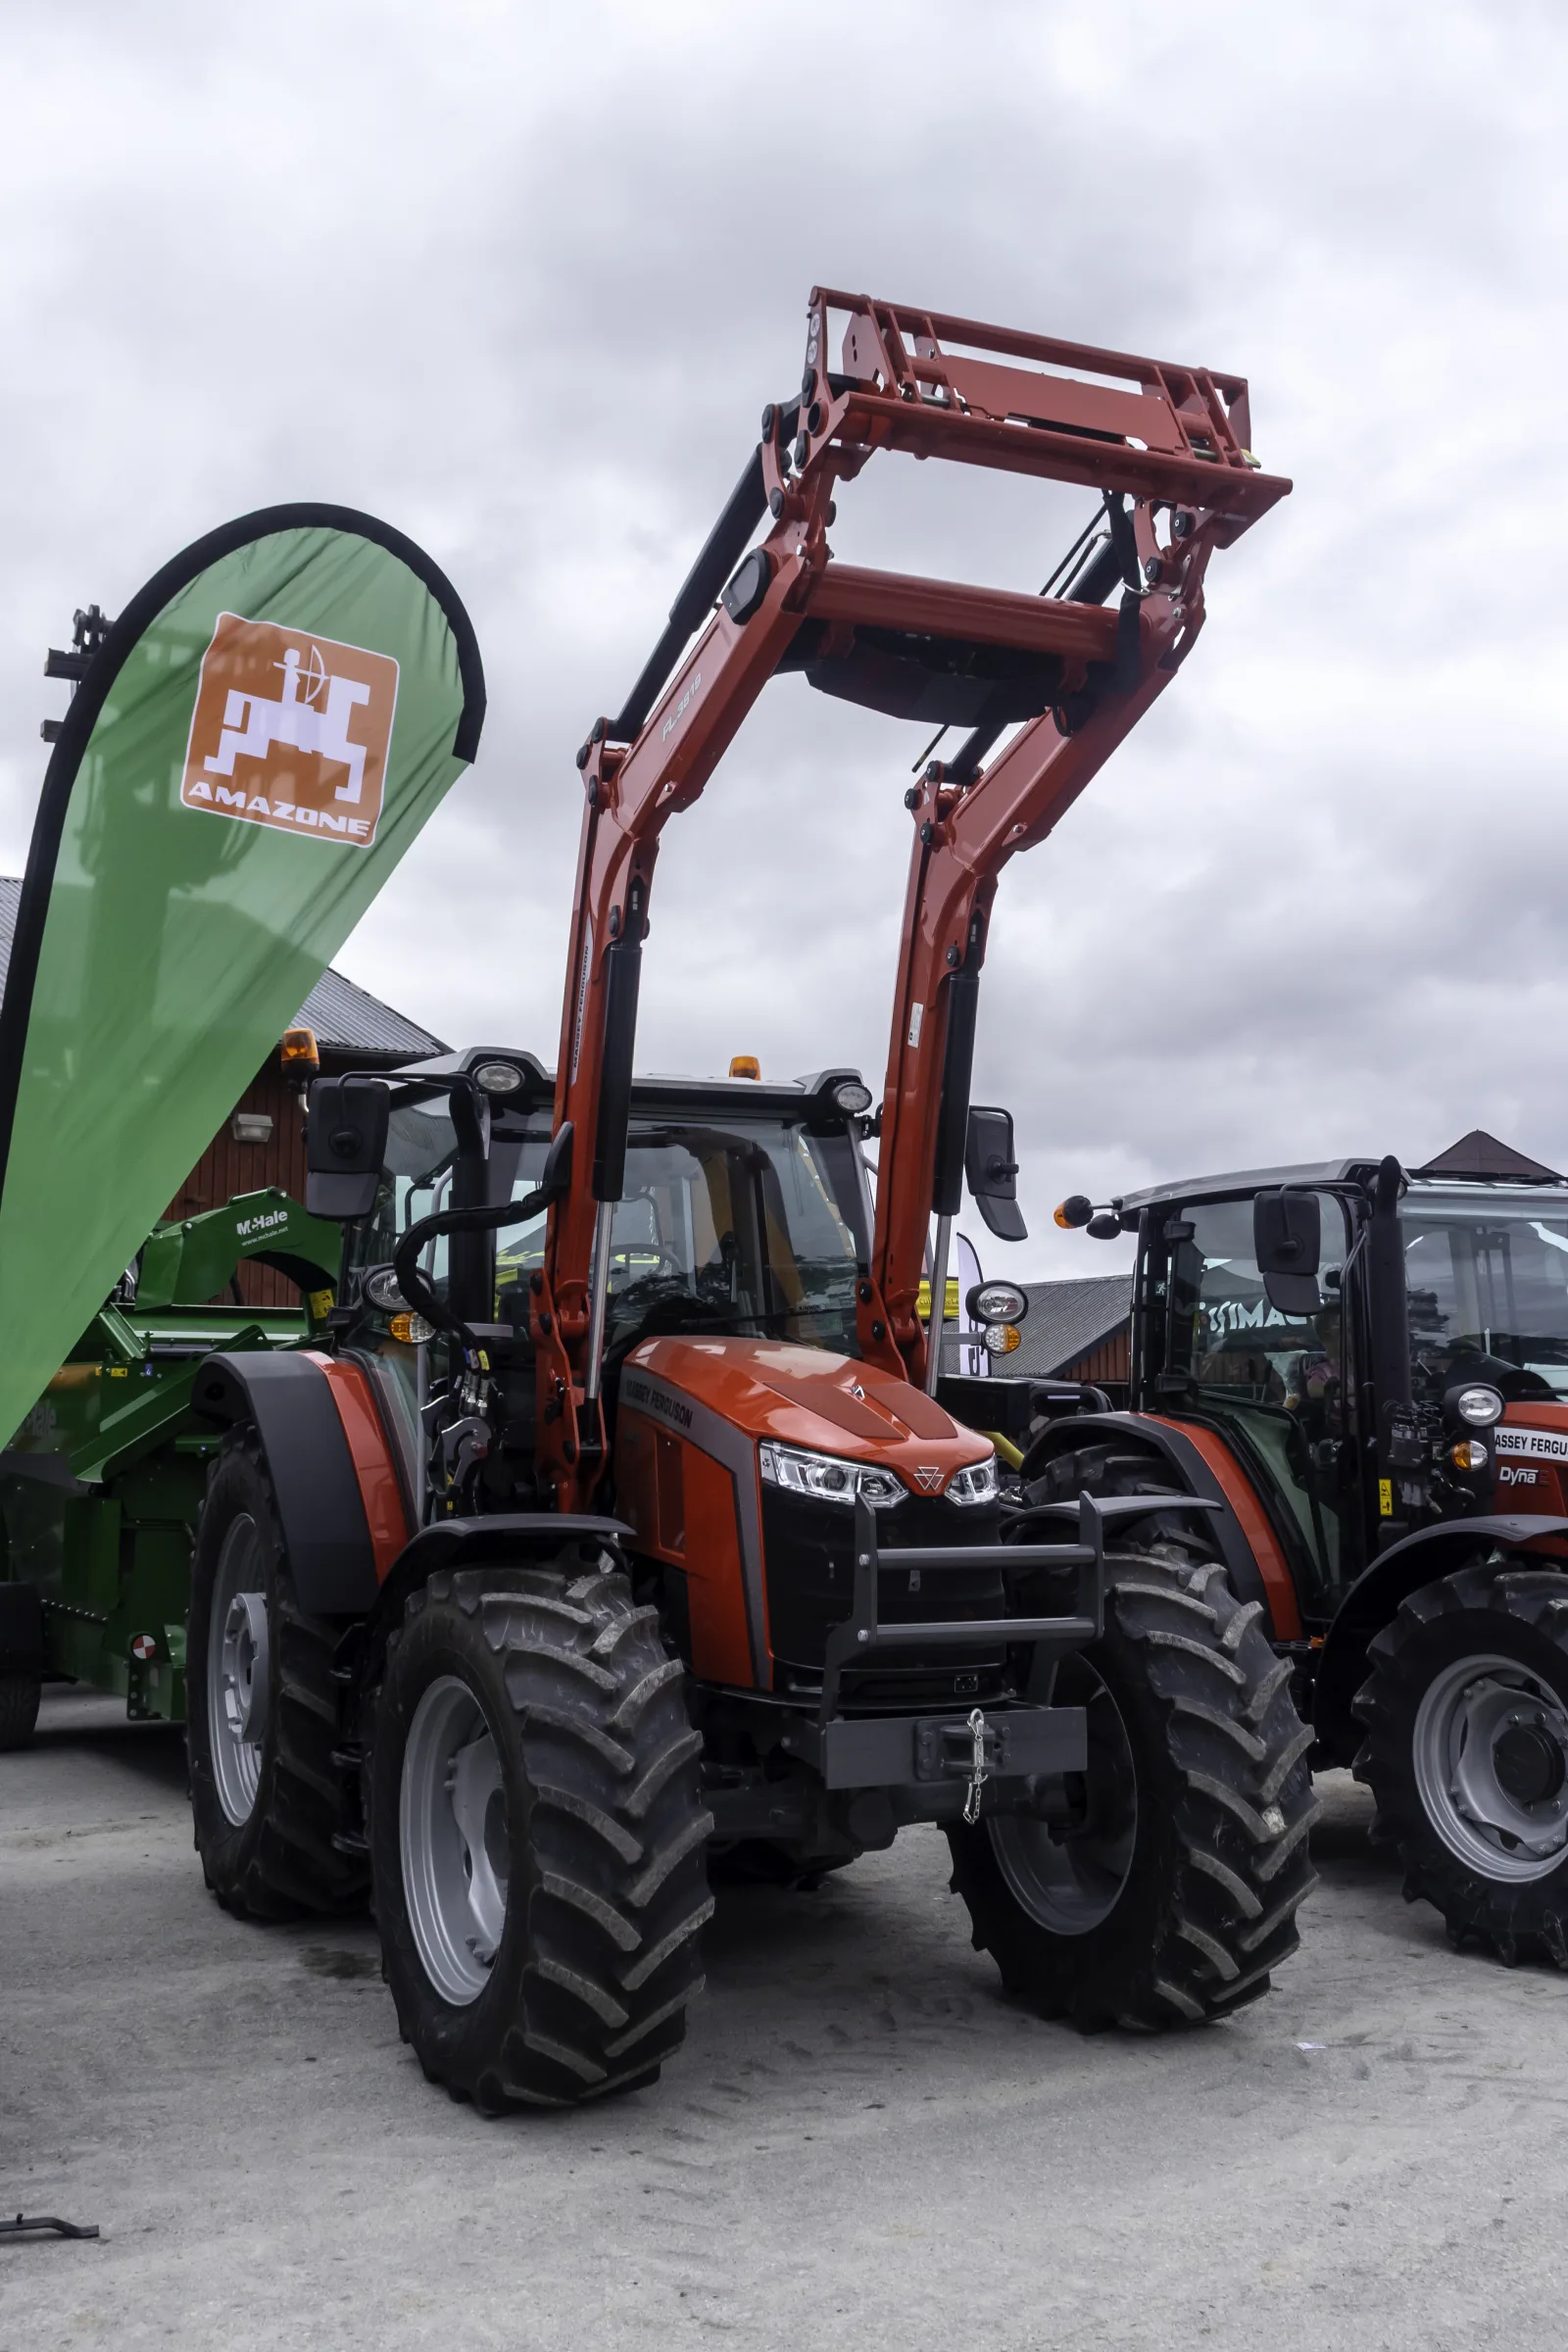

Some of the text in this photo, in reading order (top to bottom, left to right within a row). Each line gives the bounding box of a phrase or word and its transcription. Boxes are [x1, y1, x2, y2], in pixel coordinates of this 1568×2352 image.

[187, 781, 371, 837] AMAZONE
[573, 946, 589, 1068] MASSEY FERGUSON
[236, 1210, 288, 1236] McHale
[241, 1226, 288, 1247] www.mchale.net
[650, 1389, 694, 1429] FERGUSON
[1494, 1434, 1568, 1456] ASSEY FERGU
